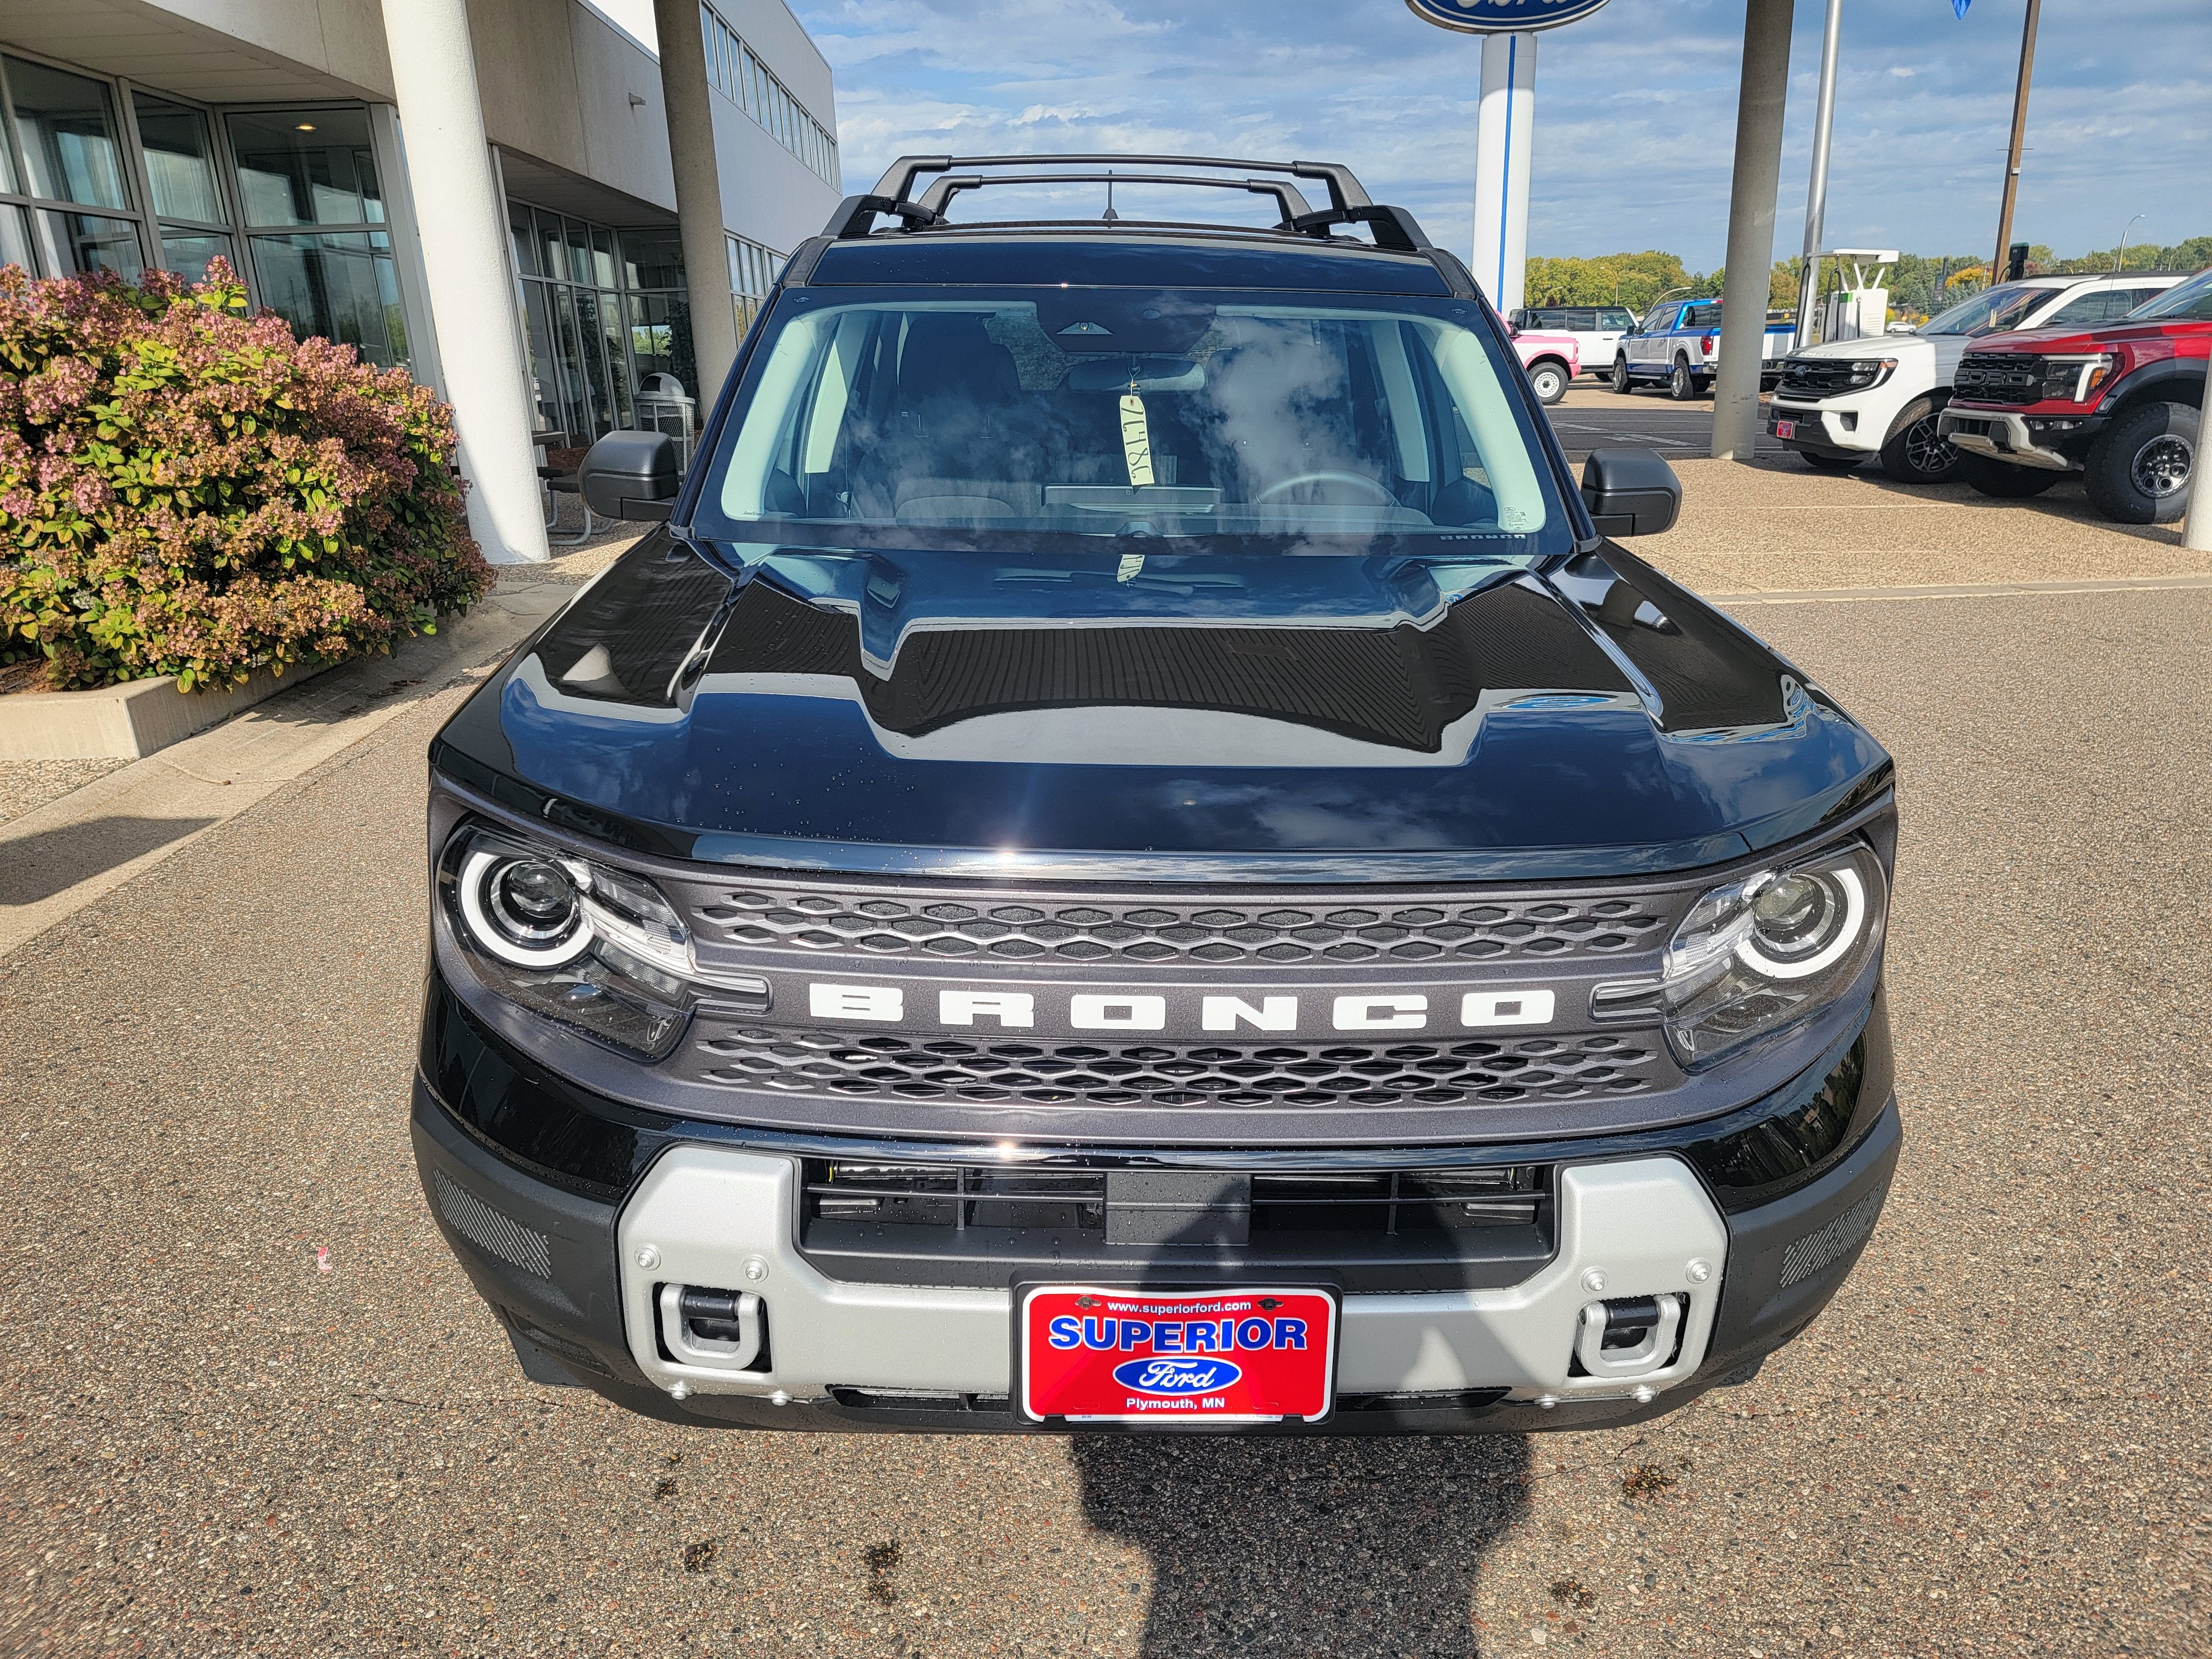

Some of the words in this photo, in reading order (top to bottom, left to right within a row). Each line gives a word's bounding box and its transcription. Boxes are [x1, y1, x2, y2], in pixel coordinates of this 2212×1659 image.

[809, 983, 1555, 1031] BRONCO
[1108, 1301, 1251, 1316] www.superiorford.com
[1048, 1315, 1308, 1353] SUPERIOR
[1139, 1361, 1217, 1387] Ford
[1126, 1397, 1197, 1410] Plymouth,
[1202, 1397, 1225, 1408] MN
